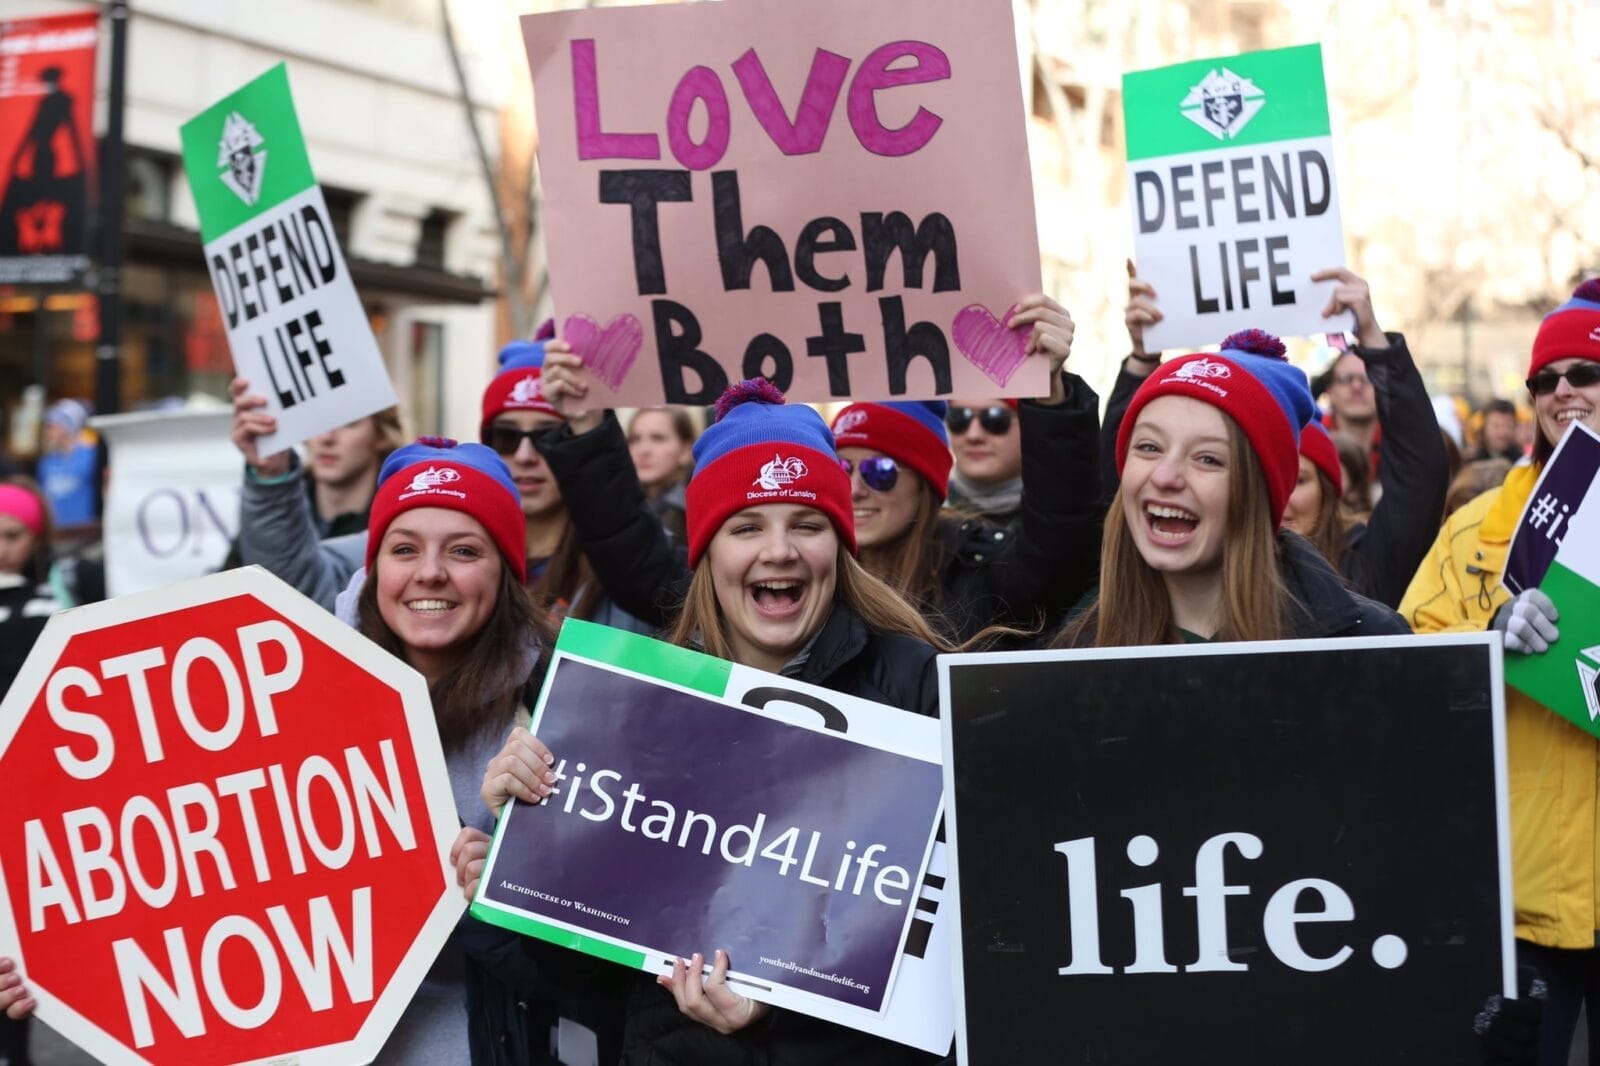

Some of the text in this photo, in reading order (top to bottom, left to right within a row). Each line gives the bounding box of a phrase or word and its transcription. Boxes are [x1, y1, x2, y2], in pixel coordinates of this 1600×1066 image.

[570, 39, 951, 171] Love
[600, 169, 961, 295] Them
[1135, 150, 1331, 234] DEFEND
[211, 204, 337, 330] DEFEND
[1189, 235, 1296, 315] LIFE
[258, 310, 346, 409] LIFE
[652, 295, 953, 404] Both
[747, 489, 817, 501] Diocese of Lansing
[46, 619, 303, 780] STOP
[24, 738, 418, 933] ABORTION
[1053, 832, 1408, 976] life.
[111, 886, 374, 1050] NOW
[758, 956, 871, 994] youthrallyandmassforlife.org
